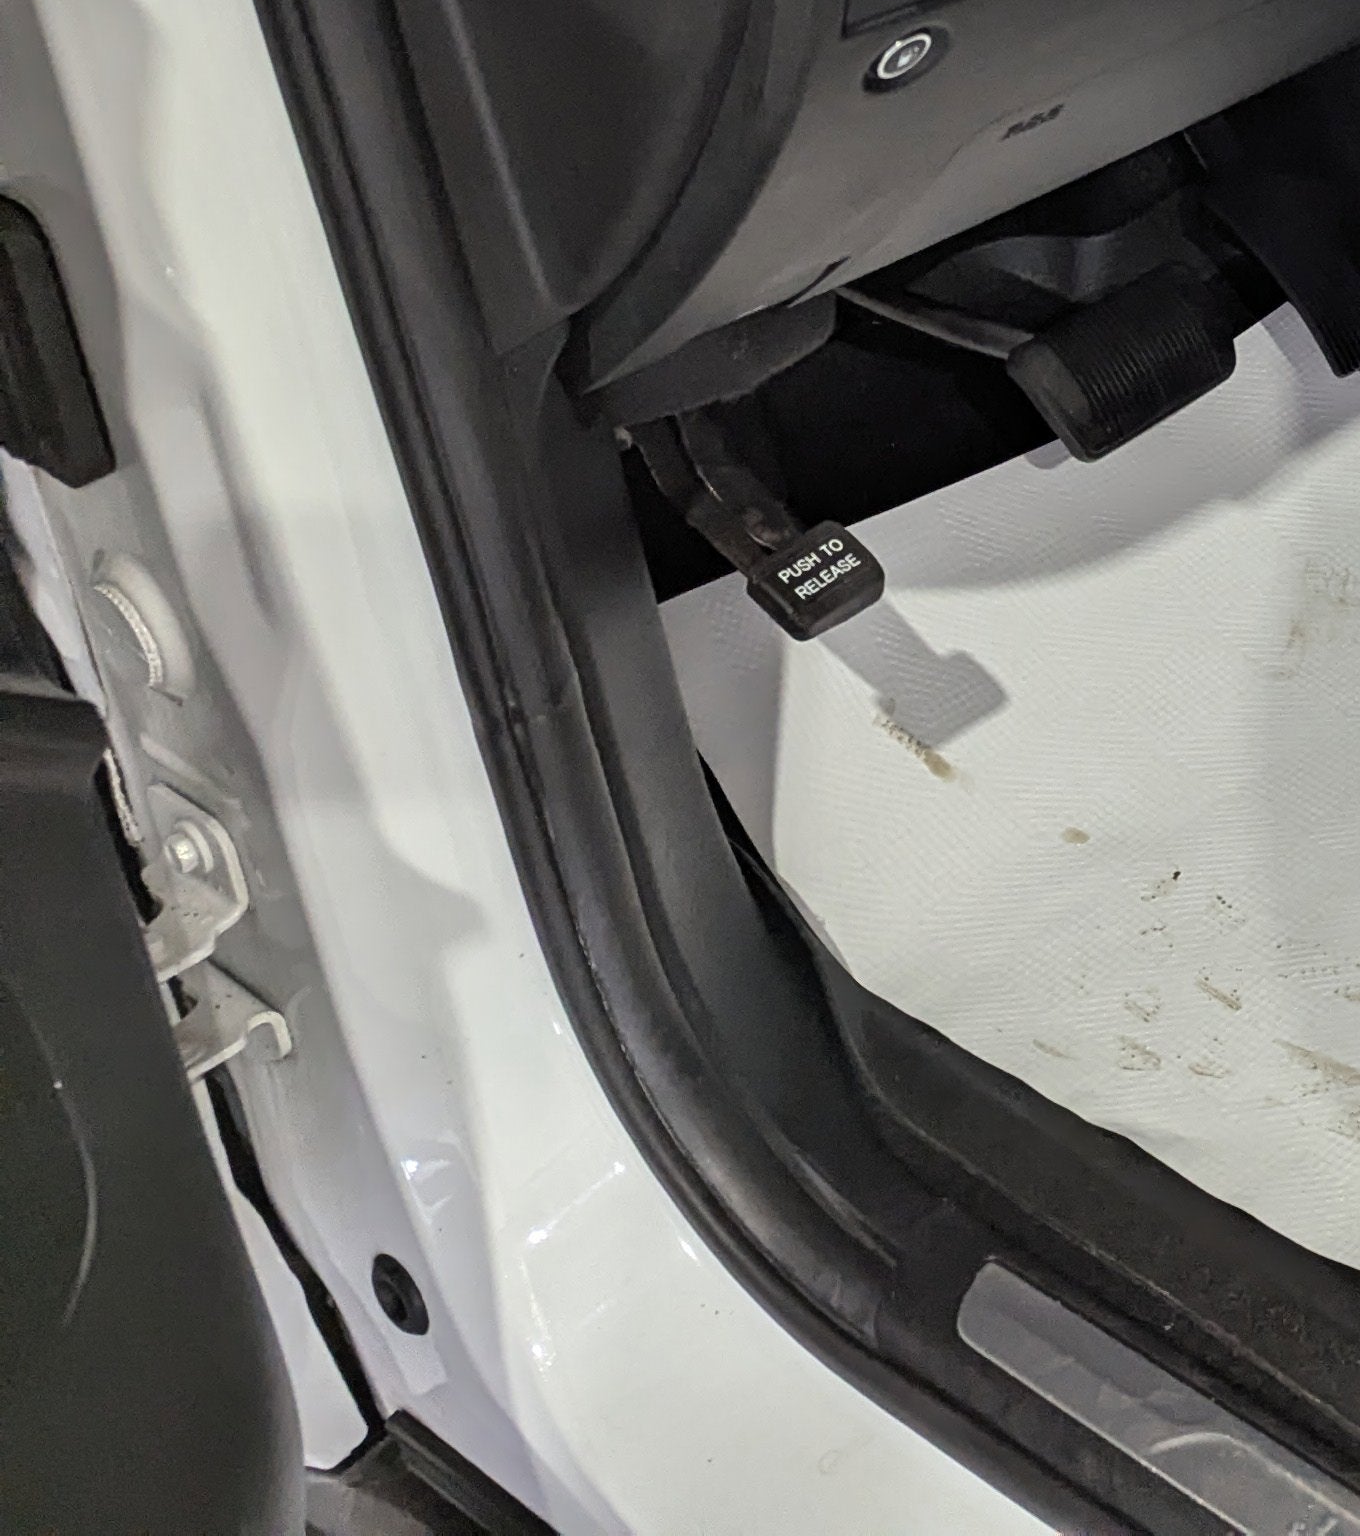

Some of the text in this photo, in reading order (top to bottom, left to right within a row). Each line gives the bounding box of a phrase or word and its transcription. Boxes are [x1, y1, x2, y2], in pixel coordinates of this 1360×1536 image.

[777, 538, 844, 585] PUSH TO
[794, 552, 862, 601] RELEASE
